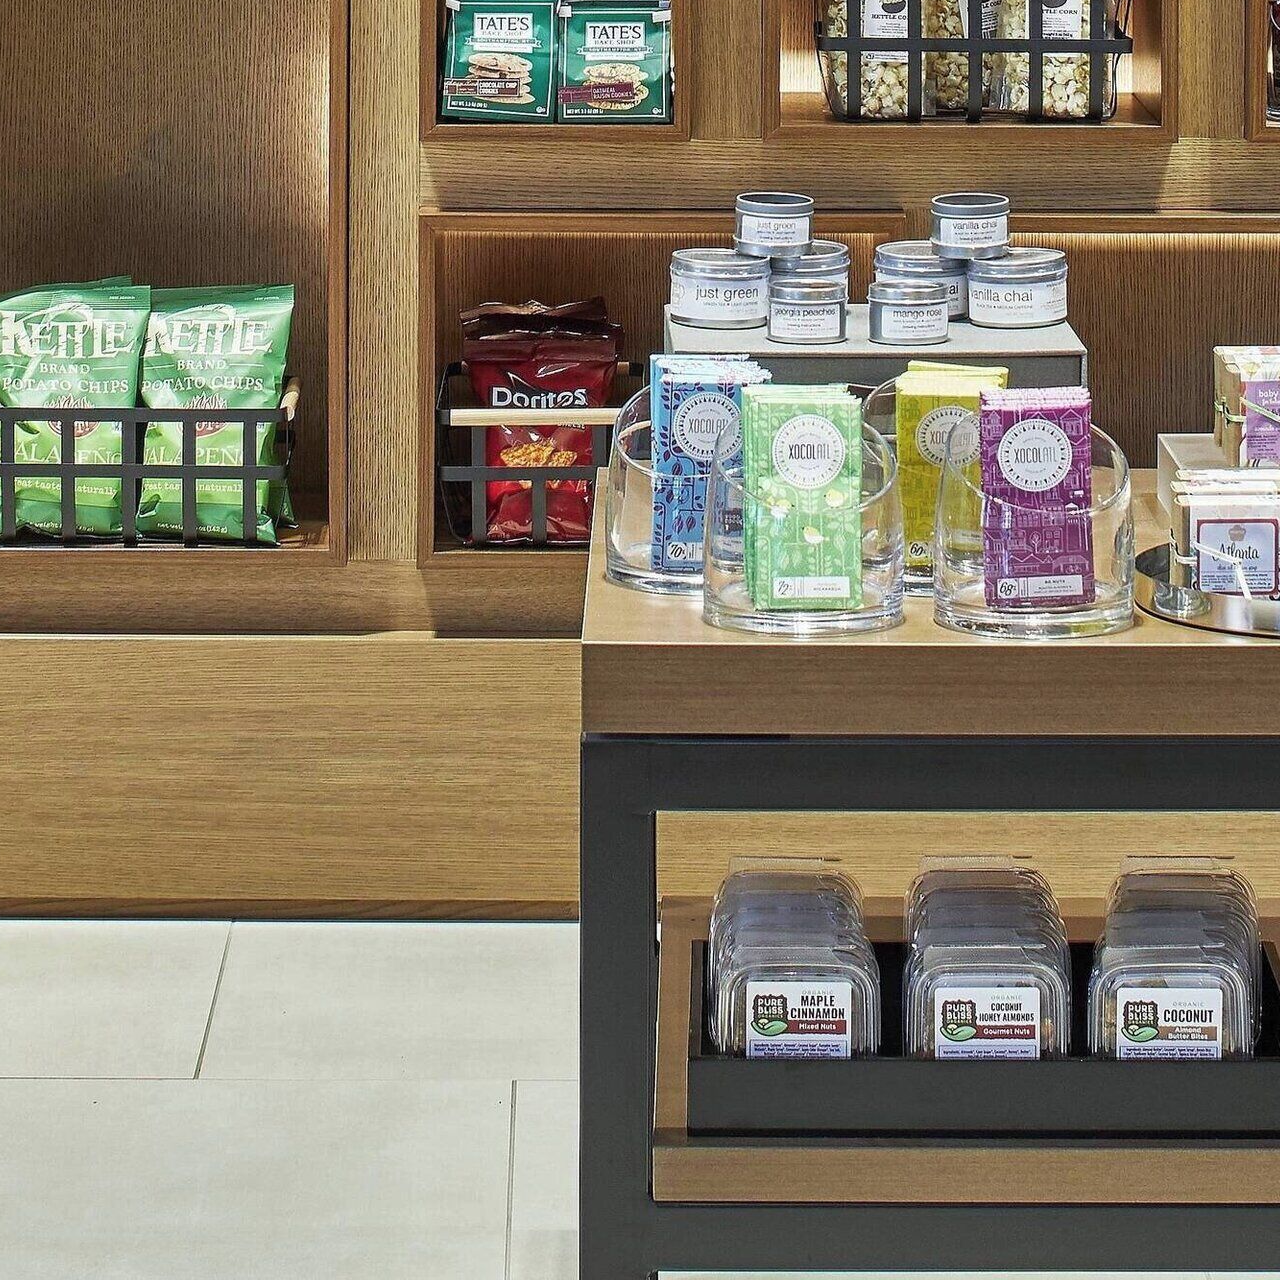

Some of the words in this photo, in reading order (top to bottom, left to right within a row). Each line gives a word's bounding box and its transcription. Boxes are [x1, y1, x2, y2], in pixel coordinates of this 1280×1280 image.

[477, 16, 530, 31] TATE'S
[589, 25, 642, 40] TATE'S
[952, 221, 979, 230] vanilla
[696, 285, 719, 301] just
[723, 286, 759, 302] green
[1004, 288, 1033, 302] chai
[802, 307, 836, 317] peaches
[893, 308, 924, 318] mango
[926, 307, 943, 317] rose
[140, 304, 274, 358] KETTLE
[40, 362, 92, 375] BRAND
[177, 360, 226, 371] BRAND
[2, 378, 72, 392] POTATO
[77, 379, 130, 393] CHIPS
[141, 377, 206, 392] POTATO
[210, 376, 264, 391] CHIPS
[491, 386, 589, 409] Doritos
[1258, 389, 1279, 400] baby
[788, 443, 833, 460] XOCOLATL
[1014, 446, 1058, 464] XOCOLATL
[758, 999, 783, 1007] PURE
[800, 995, 835, 1008] MAPLE
[758, 1007, 784, 1015] BLISS
[946, 1003, 972, 1012] PURE
[991, 1003, 1023, 1012] COCONUT
[1128, 1004, 1154, 1013] PURE
[790, 1007, 845, 1020] CINNAMON
[946, 1011, 972, 1020] BLISS
[979, 1012, 1000, 1022] HONEY
[1002, 1012, 1035, 1022] ALMONDS
[1128, 1012, 1154, 1021] BLISS
[1163, 1009, 1214, 1023] COCONUT
[983, 1027, 1011, 1036] Gourmet
[1013, 1027, 1031, 1036] Nuts
[1168, 1032, 1191, 1040] Butter
